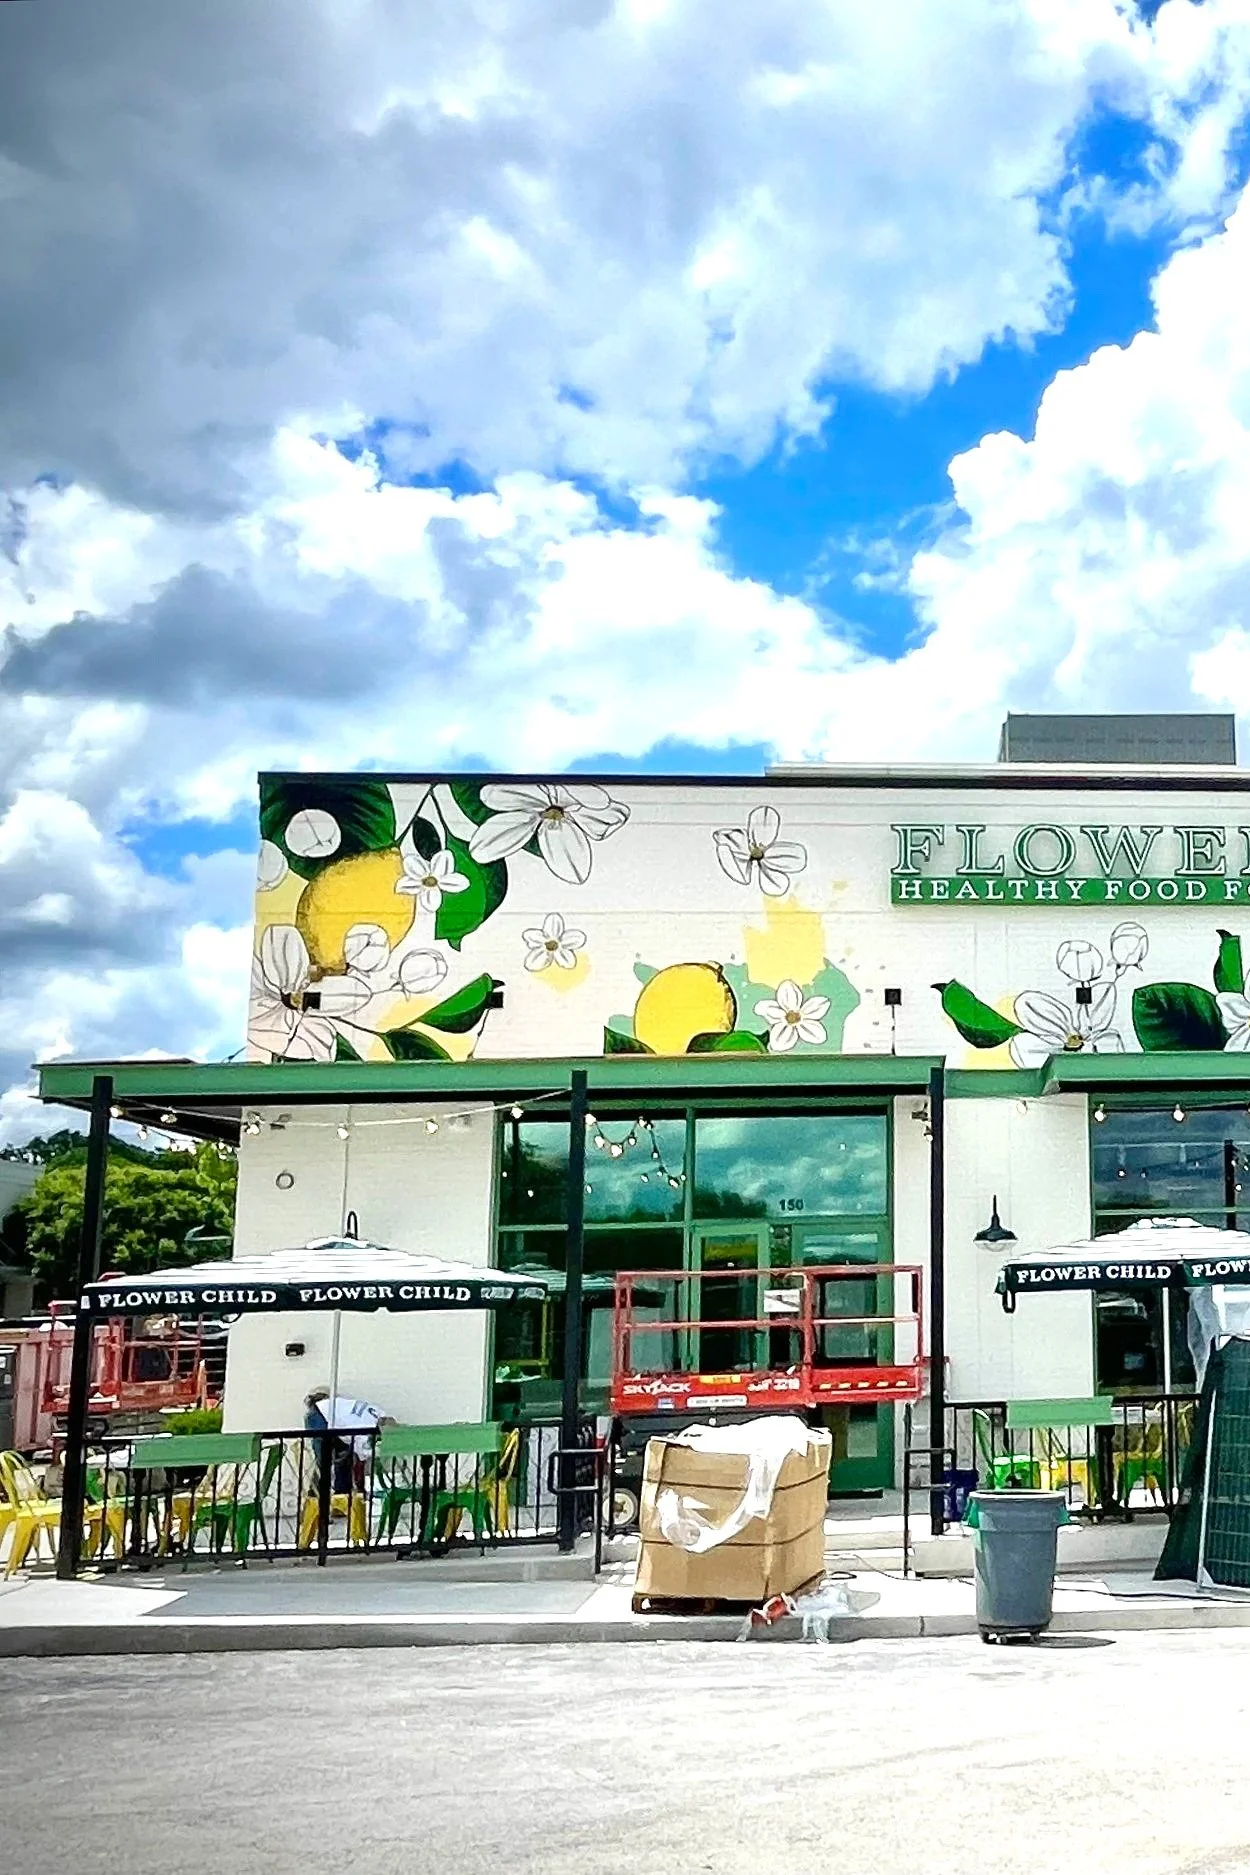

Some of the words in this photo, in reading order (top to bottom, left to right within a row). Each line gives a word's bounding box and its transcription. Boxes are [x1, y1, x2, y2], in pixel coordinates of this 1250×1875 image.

[900, 879, 1088, 900] HEALTHY
[1104, 879, 1207, 900] FOOD
[779, 1198, 804, 1212] 150
[1016, 1265, 1101, 1284] FLOWER
[1106, 1264, 1172, 1280] CHILD
[98, 1289, 196, 1308] FLOWER
[201, 1289, 277, 1304] CHILD
[299, 1286, 394, 1303] FLOWER
[399, 1285, 472, 1302] CHILD
[623, 1379, 691, 1395] SKYJACK
